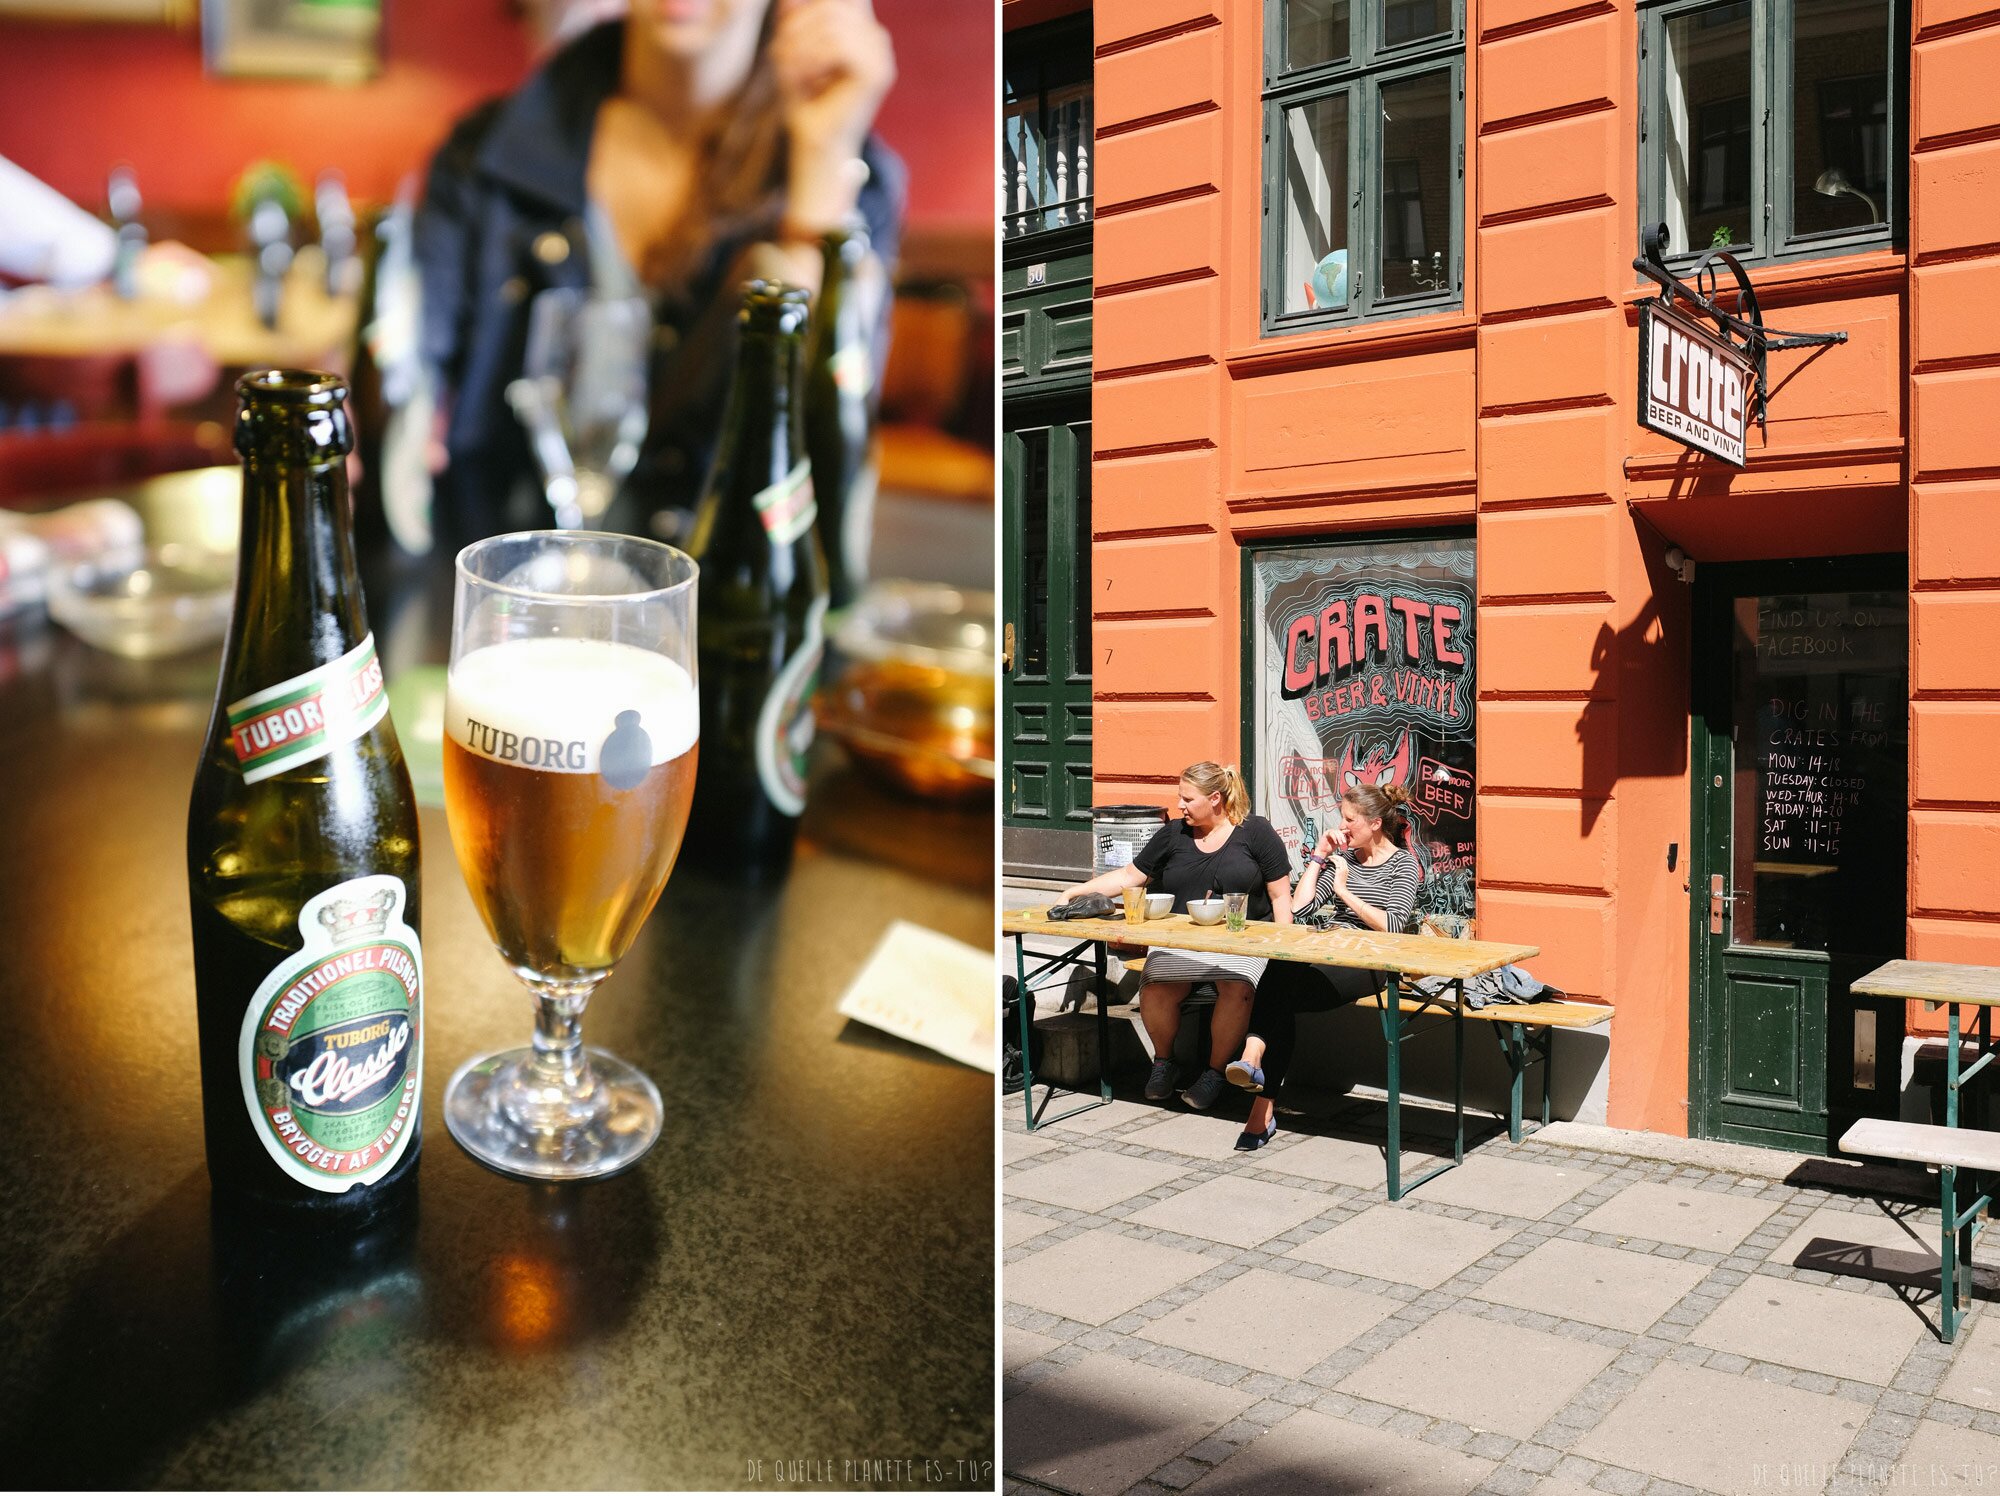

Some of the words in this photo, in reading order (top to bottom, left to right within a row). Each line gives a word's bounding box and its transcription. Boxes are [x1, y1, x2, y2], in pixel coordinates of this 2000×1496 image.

[1649, 404, 1683, 431] BEER
[1685, 421, 1710, 442] AND
[1712, 432, 1743, 460] VINYL
[1758, 609, 1804, 630] FIND
[1815, 610, 1843, 628] US
[1854, 611, 1882, 628] ON
[1283, 594, 1465, 696] CRATE
[1753, 634, 1855, 657] FACEBOOK
[1304, 680, 1366, 722] BEER
[1369, 674, 1388, 708] &
[1394, 669, 1461, 719] VINYL
[1770, 699, 1809, 721] DIG
[1818, 702, 1839, 721] IN
[1850, 701, 1886, 723] THE
[237, 697, 331, 753] TUBOR
[1769, 728, 1840, 747] CRATES
[1850, 730, 1889, 747] FROM
[466, 717, 587, 771] TUBORG
[1291, 777, 1331, 794] VINYL
[1421, 764, 1446, 786] Buy
[1448, 774, 1471, 789] more
[1766, 771, 1818, 792] TUESDAY:
[1821, 776, 1865, 790] CLOSED
[1425, 783, 1465, 810] BEER
[1765, 801, 1810, 819] FRIDAY:
[1763, 818, 1787, 833] SAT
[1763, 835, 1791, 851] SUN
[268, 951, 375, 1031] TRADITIONEL
[379, 948, 418, 998] PILSNER
[323, 1018, 392, 1051] TUBORG
[289, 1019, 410, 1108] Classic
[272, 1111, 346, 1172] BRYGGET
[348, 1147, 372, 1171] AF
[374, 1077, 416, 1155] TUBORG
